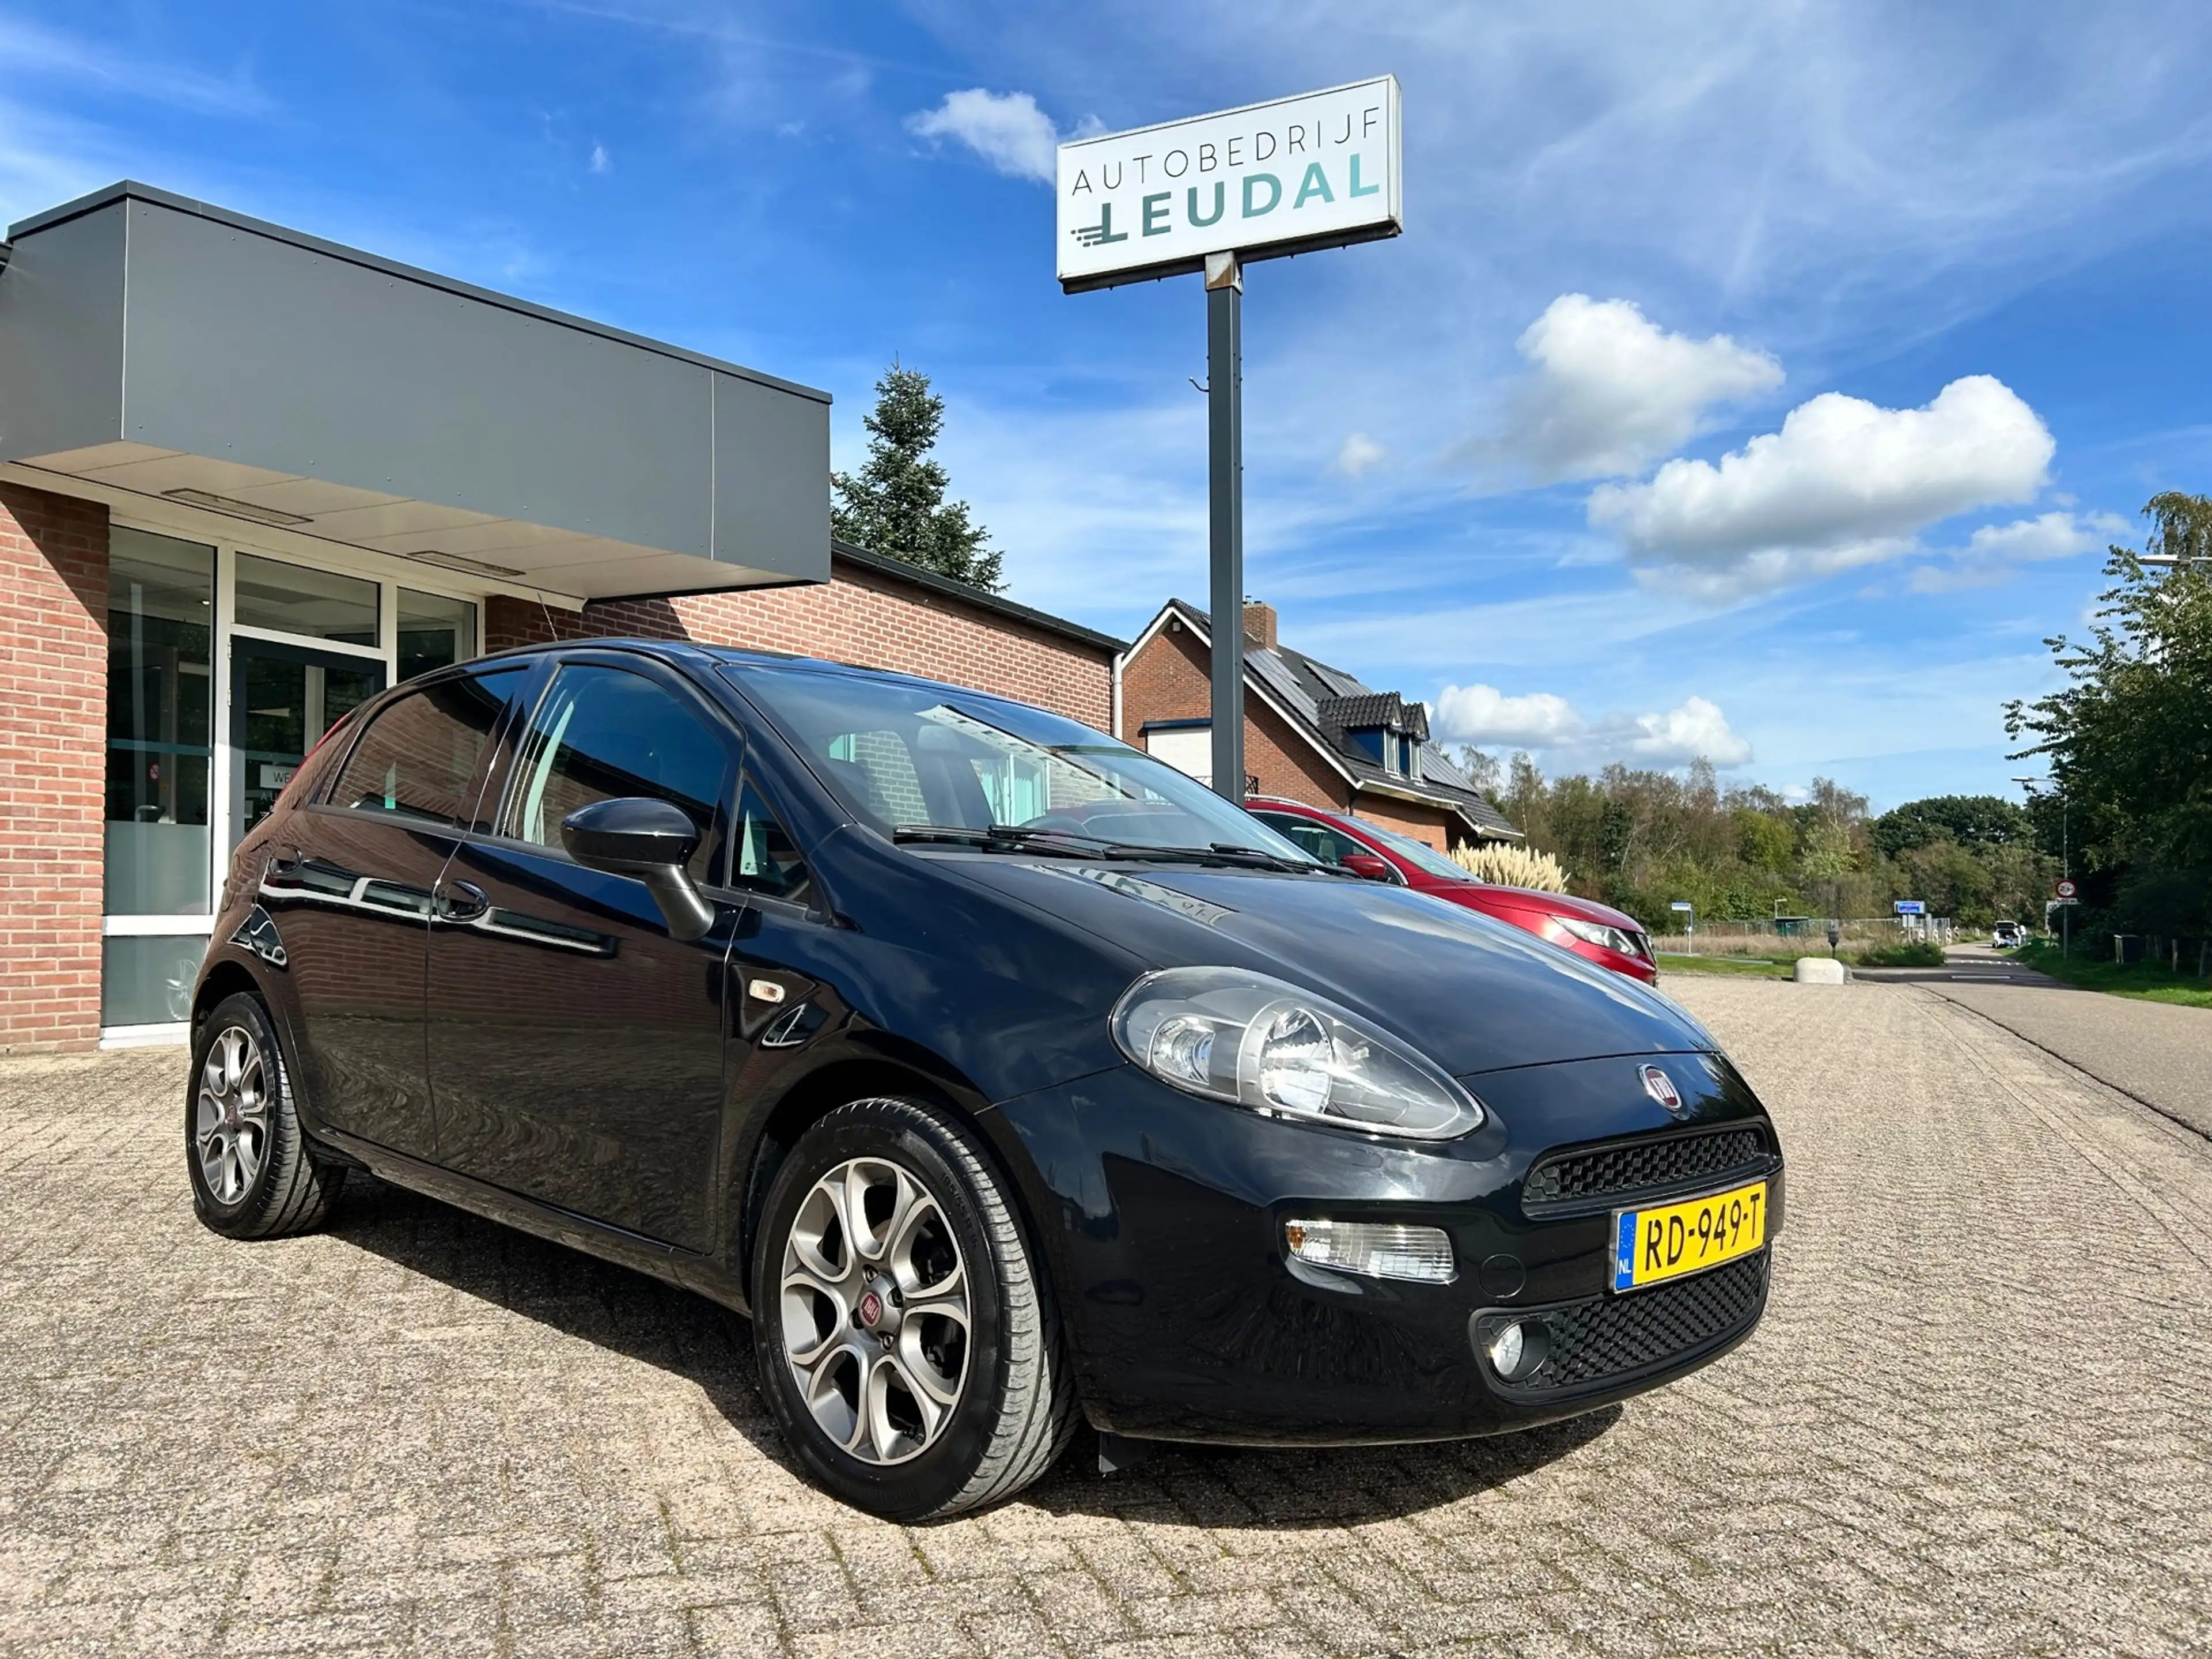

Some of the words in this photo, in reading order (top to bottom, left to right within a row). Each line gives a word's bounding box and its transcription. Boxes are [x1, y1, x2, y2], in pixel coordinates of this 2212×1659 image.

[1072, 107, 1380, 196] AUTOBEDRIJF
[1100, 153, 1380, 244] LEUDAL
[1619, 1258, 1632, 1275] NL
[1645, 1192, 1760, 1272] RD-949-T
